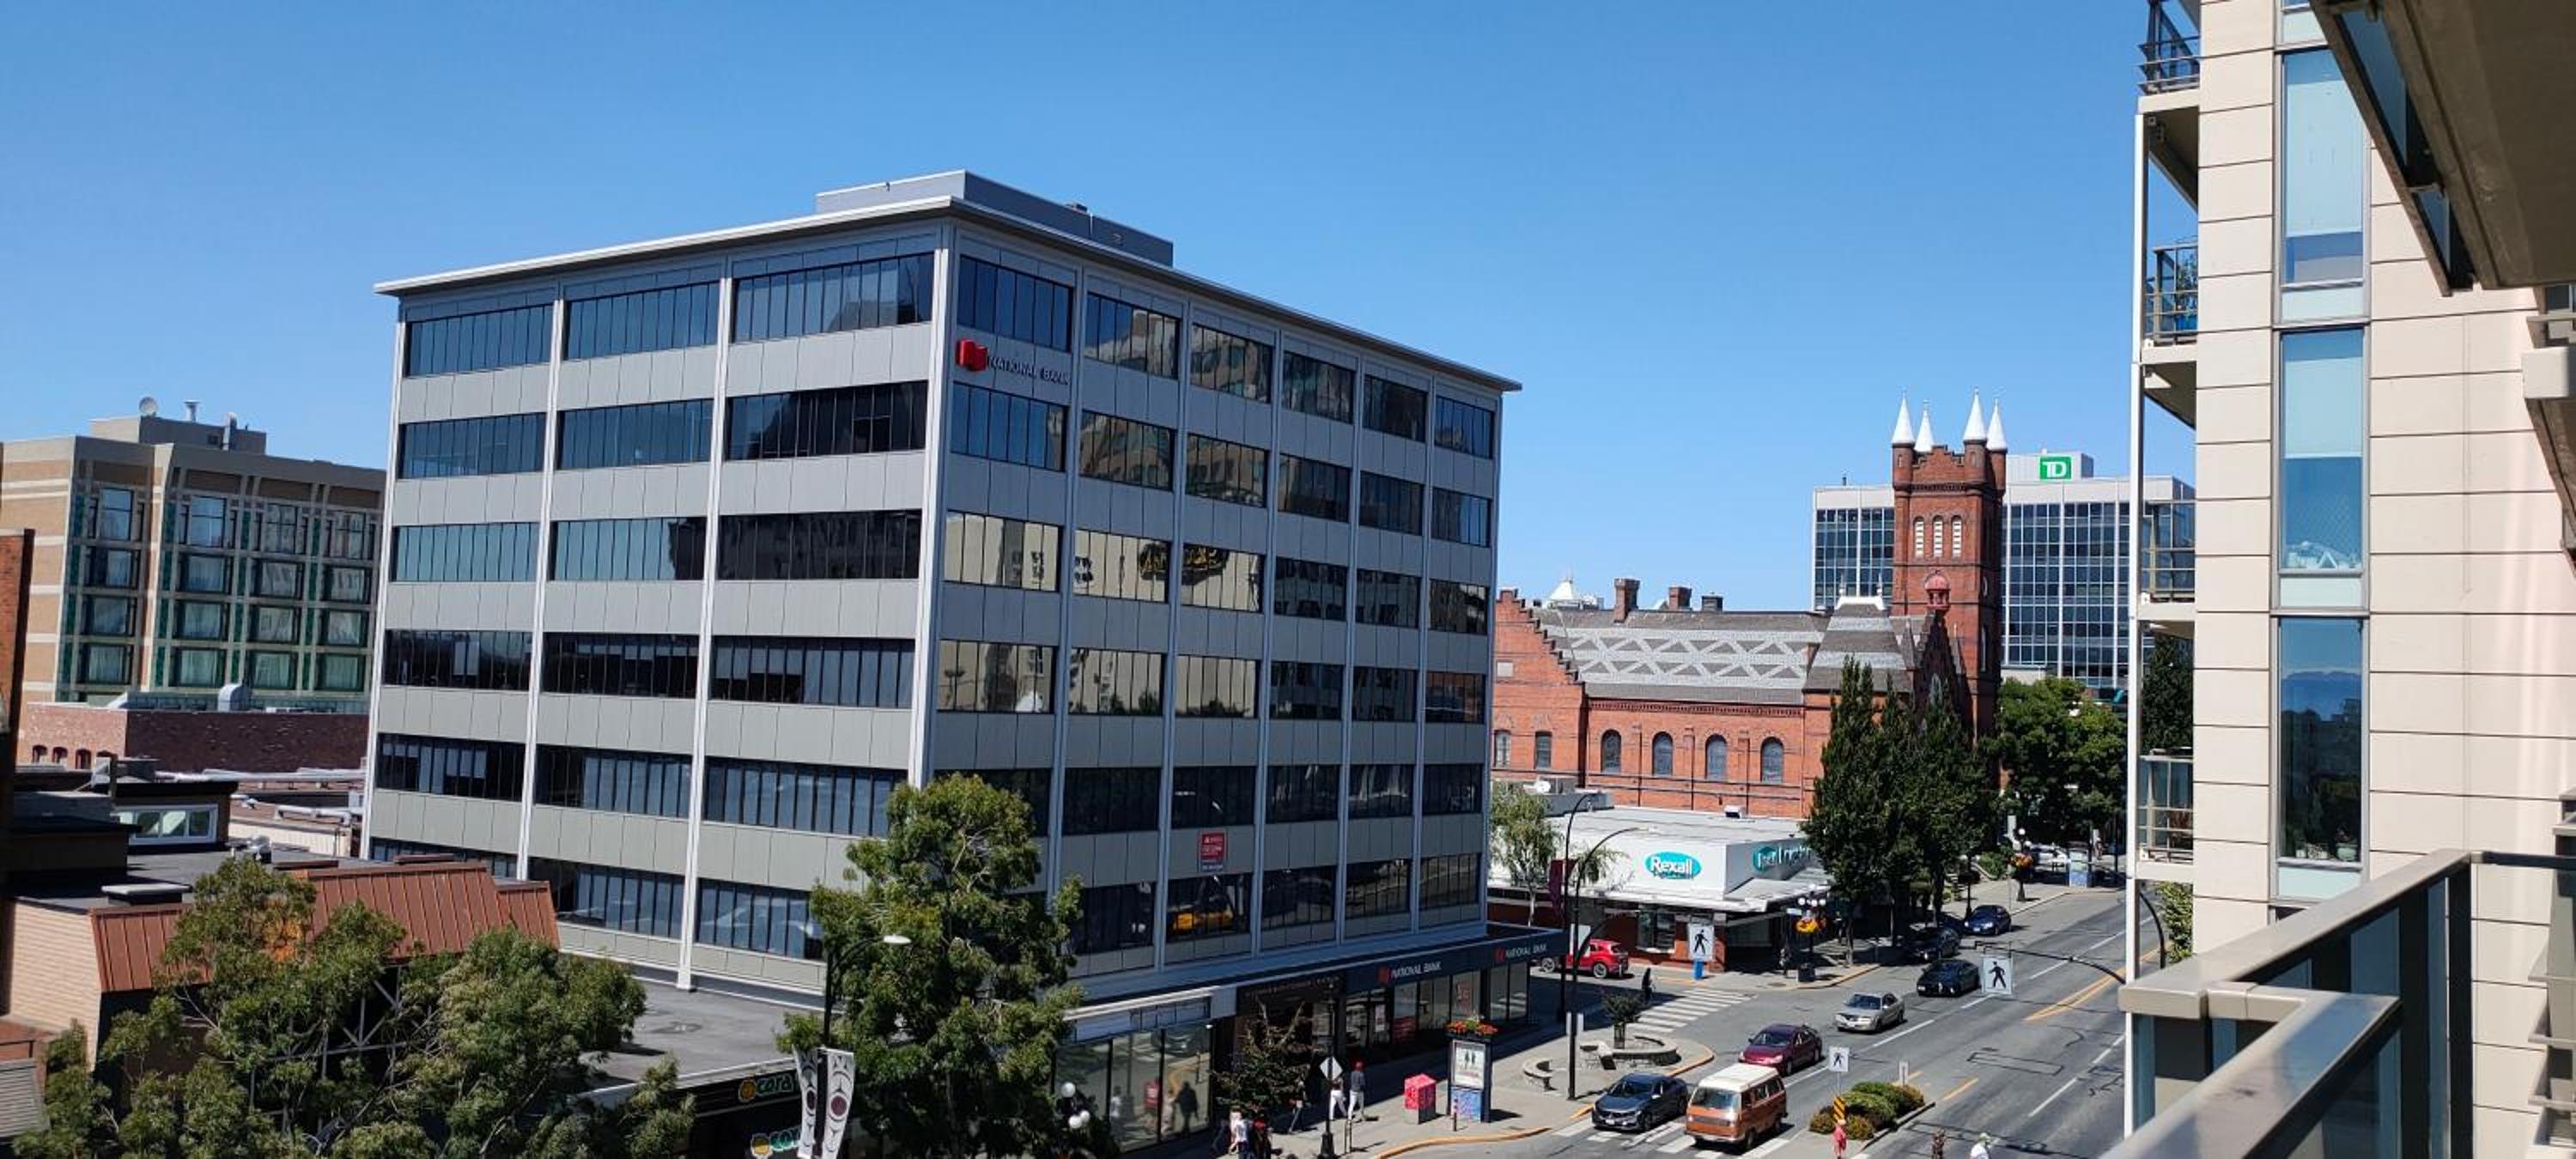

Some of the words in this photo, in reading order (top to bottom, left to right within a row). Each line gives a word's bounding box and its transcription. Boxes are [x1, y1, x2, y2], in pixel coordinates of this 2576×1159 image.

[990, 356, 1036, 379] NATIONAL
[1040, 367, 1071, 385] BANK
[2042, 461, 2067, 477] TD
[1650, 857, 1692, 874] Rexall
[1390, 963, 1422, 979] NATIONAL
[1424, 961, 1442, 974] BANK
